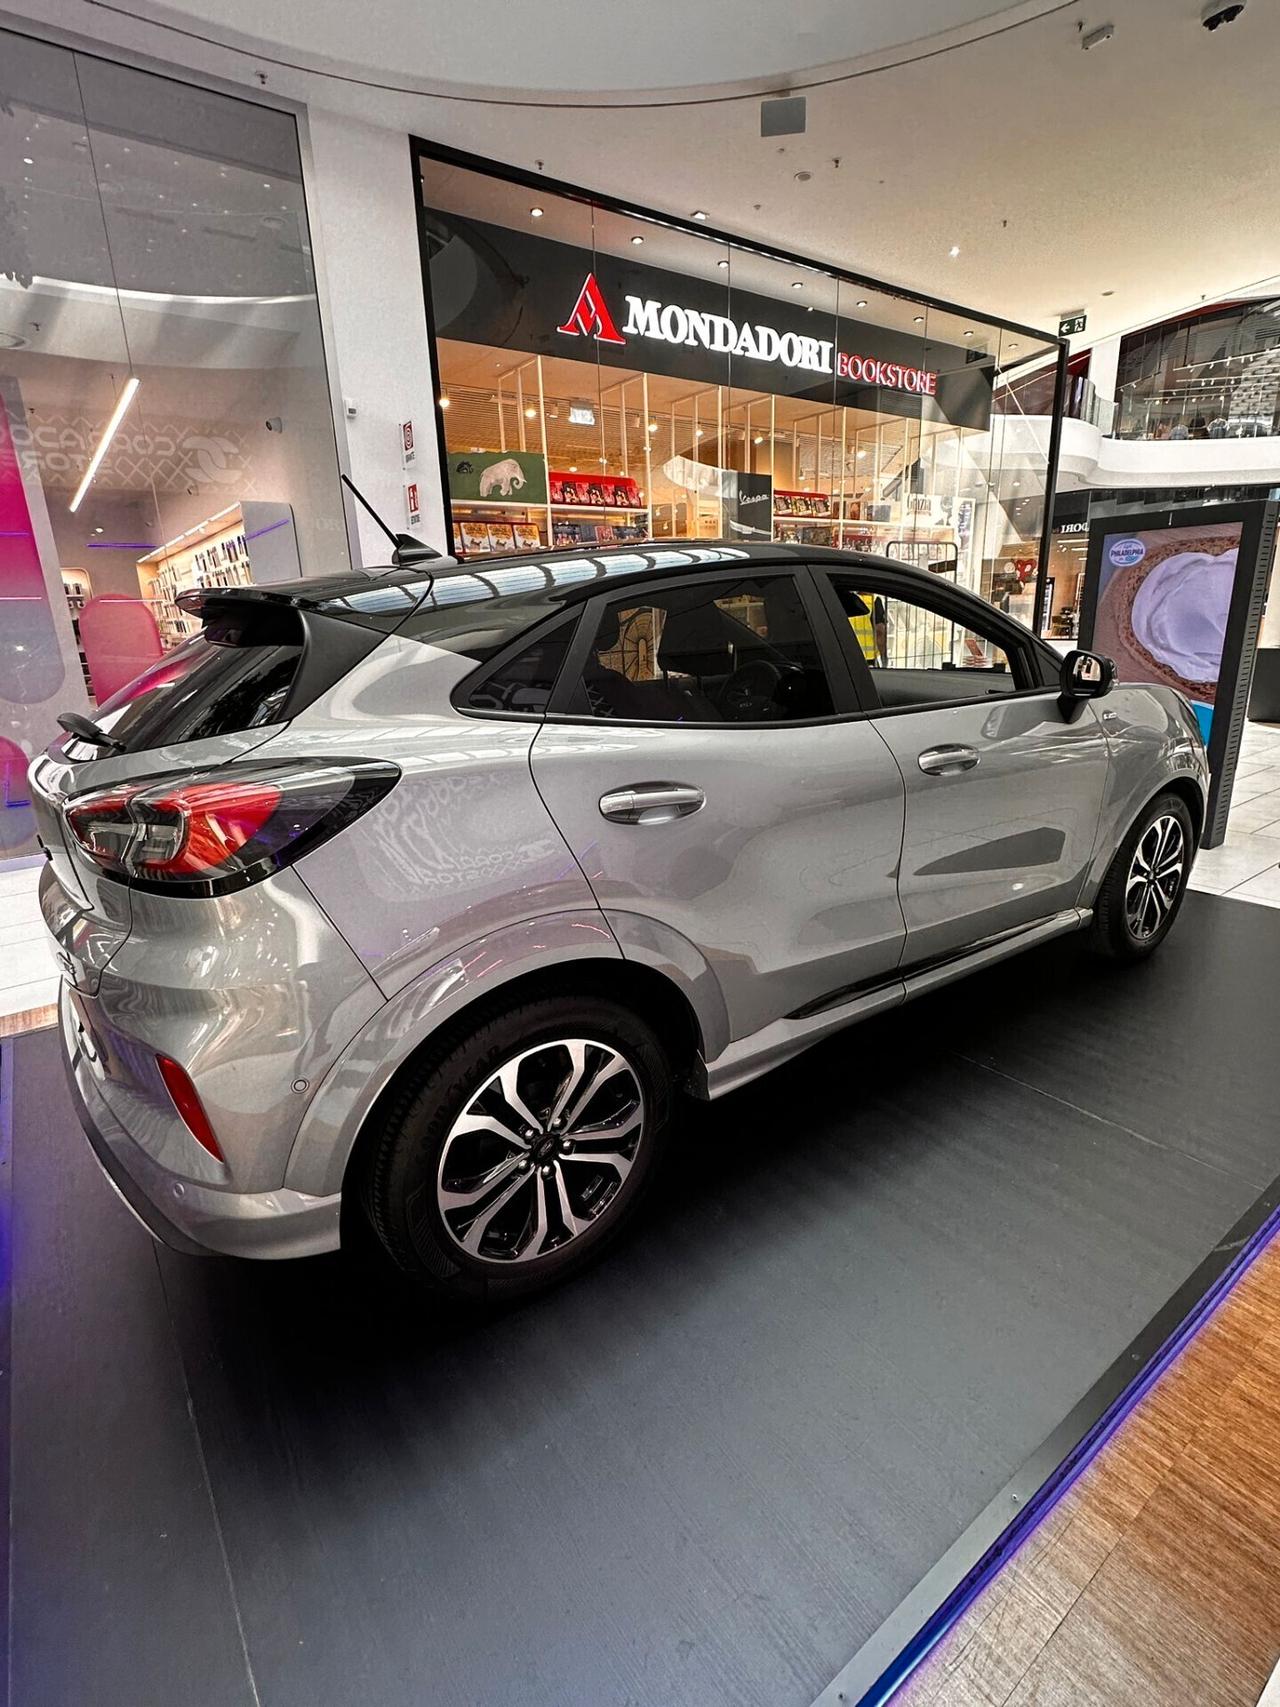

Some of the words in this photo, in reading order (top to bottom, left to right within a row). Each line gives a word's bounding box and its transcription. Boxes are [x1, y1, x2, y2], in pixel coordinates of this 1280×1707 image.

[622, 295, 834, 375] MONDADORI
[836, 352, 938, 396] BOOKSTORE
[739, 489, 769, 506] Vespa
[1110, 547, 1144, 558] PHILADELPHIA
